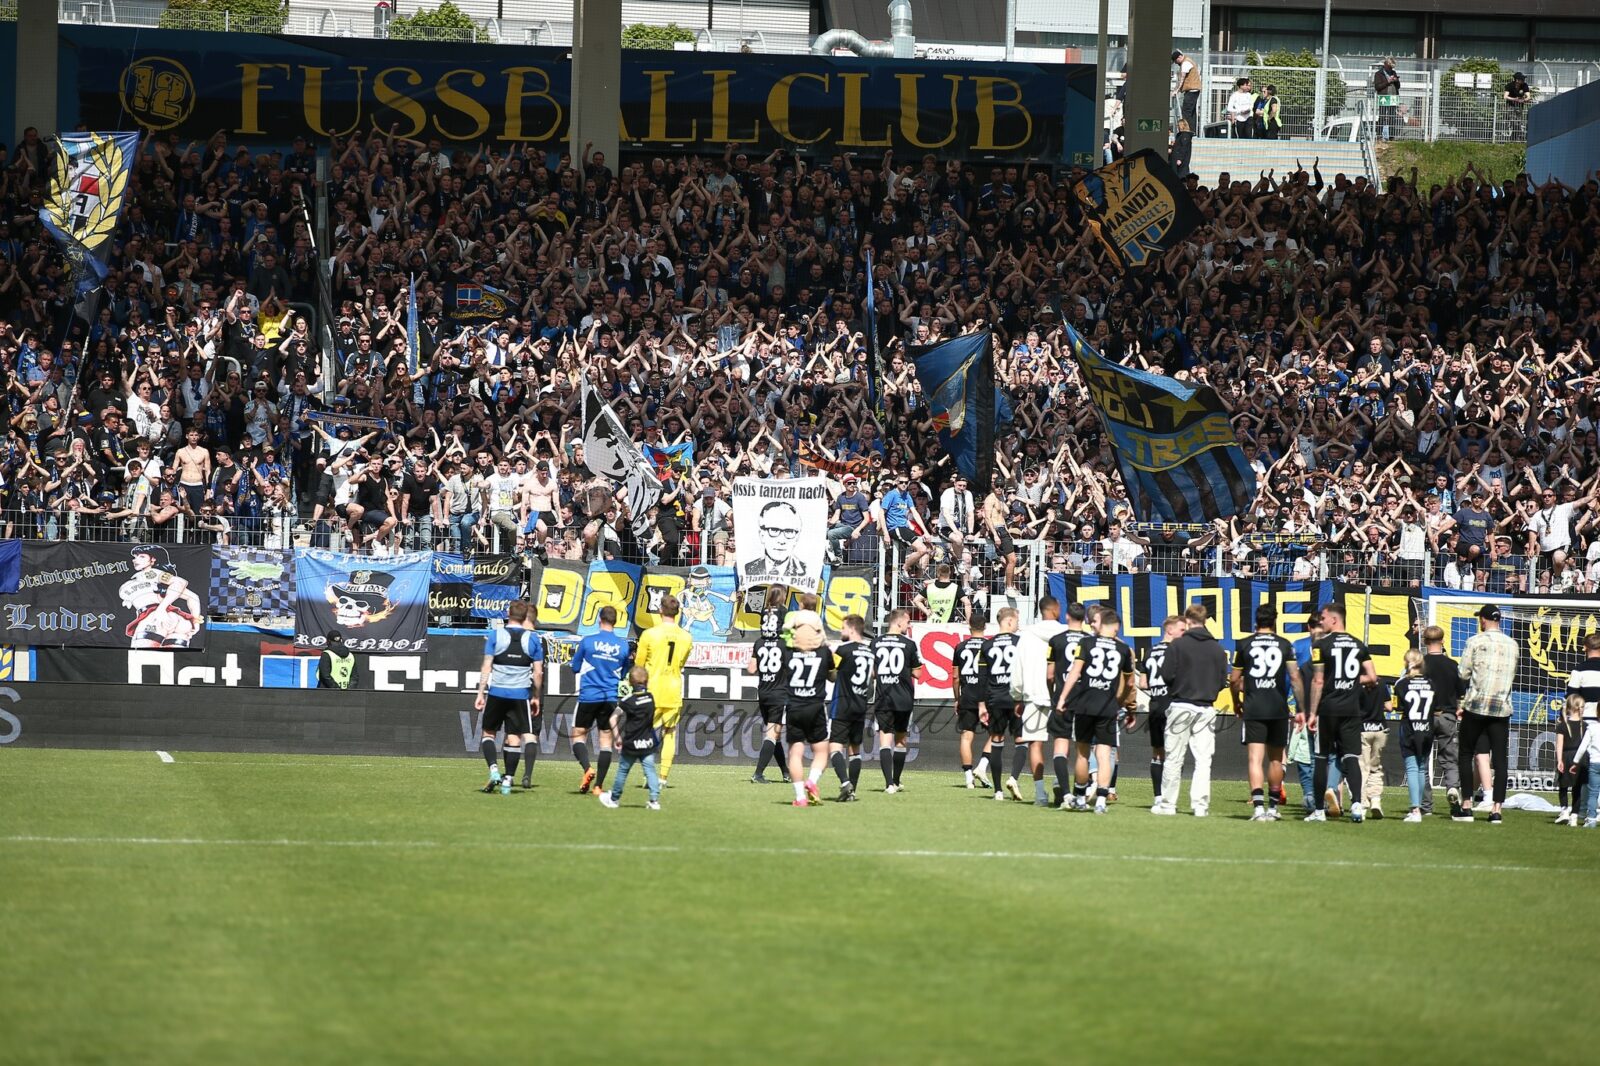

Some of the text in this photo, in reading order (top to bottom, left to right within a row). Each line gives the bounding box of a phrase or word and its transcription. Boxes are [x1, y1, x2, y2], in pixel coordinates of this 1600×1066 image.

[759, 484, 796, 499] tanzen
[798, 484, 826, 500] nach
[433, 558, 509, 576] Kommando
[536, 567, 872, 632] DROOS
[3, 603, 116, 633] Luder
[761, 614, 779, 631] 28
[293, 633, 427, 652] ROENHOF
[667, 641, 676, 666] 1
[757, 646, 782, 673] 28
[788, 657, 822, 688] 27
[876, 646, 905, 675] 20
[987, 645, 1017, 675] 29
[1086, 646, 1122, 680] 33
[1249, 646, 1283, 678] 39
[1330, 647, 1361, 679] 16
[1404, 690, 1435, 721] 27
